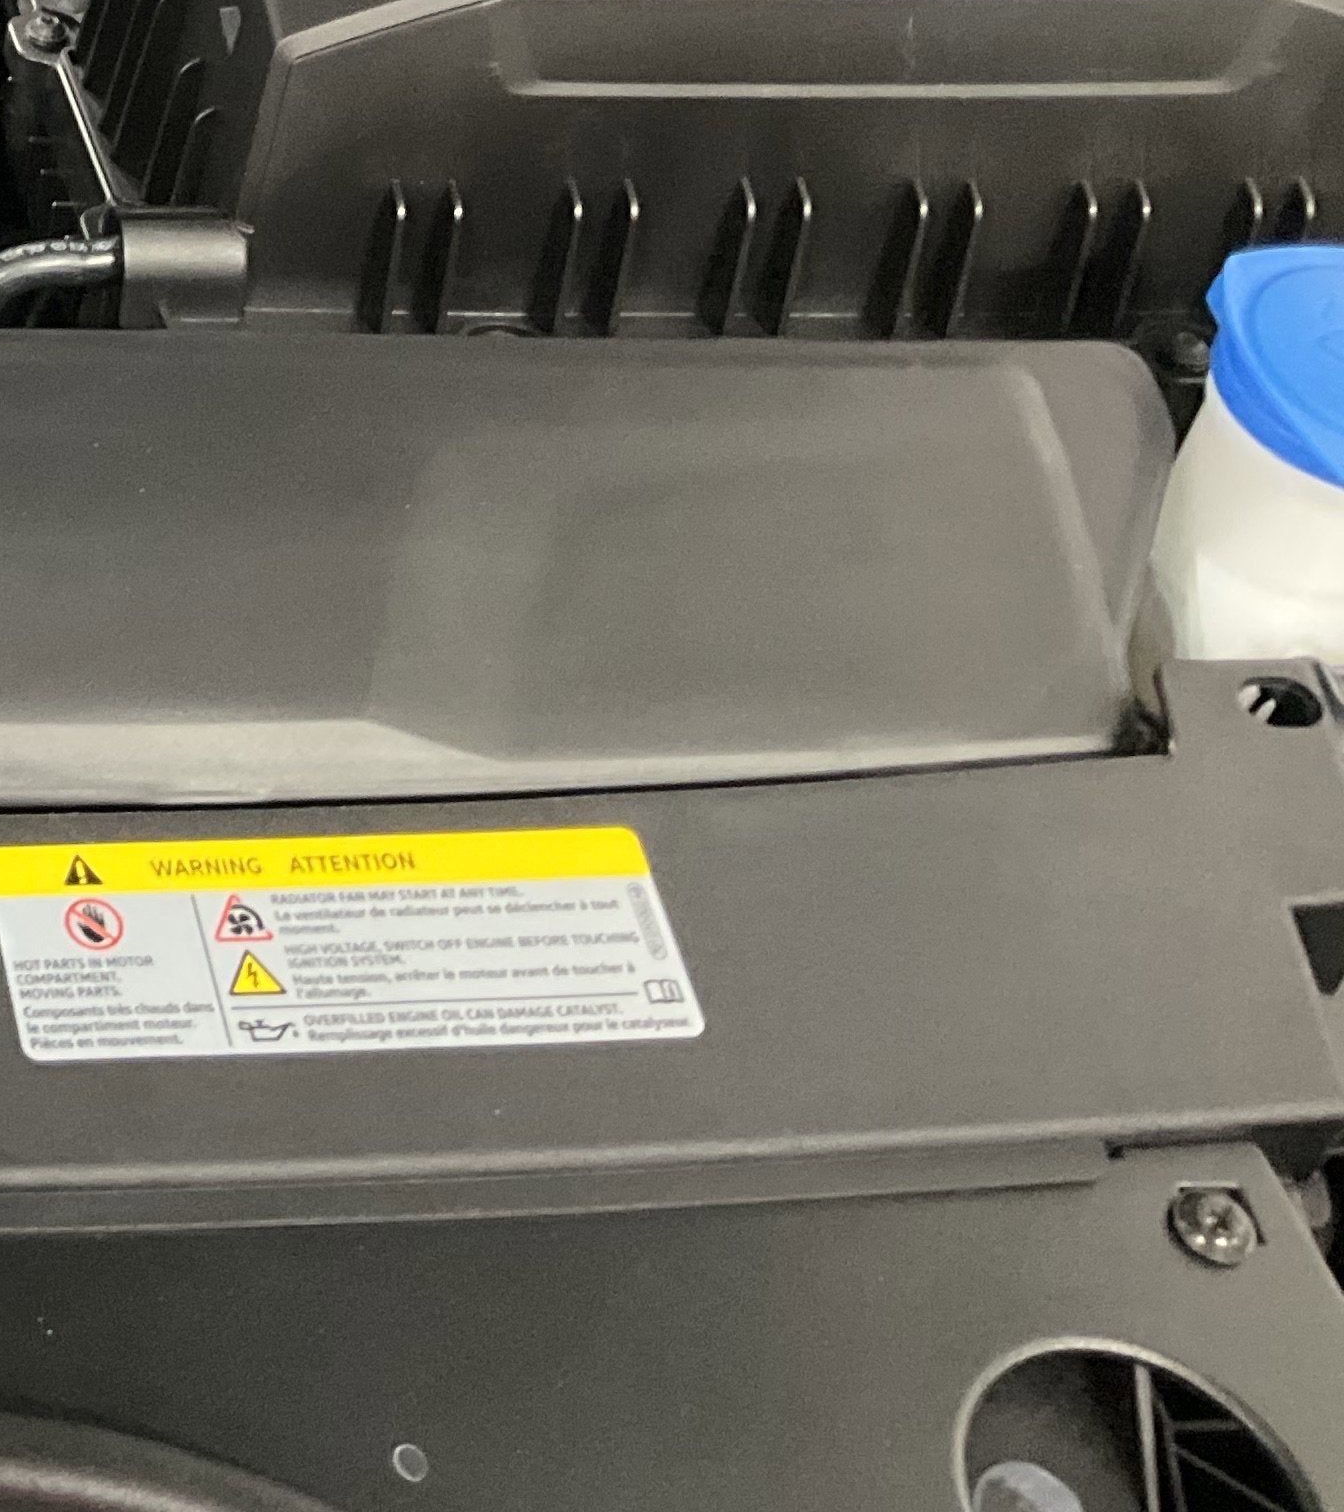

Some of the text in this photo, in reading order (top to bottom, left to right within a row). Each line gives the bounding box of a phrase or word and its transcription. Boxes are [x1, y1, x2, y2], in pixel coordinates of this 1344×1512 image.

[150, 852, 417, 878] WARNING ATTENTION
[271, 892, 335, 904] RADIATOR
[44, 958, 85, 970] PARTS
[107, 955, 154, 967] MOTOR
[20, 987, 75, 999] MOVING
